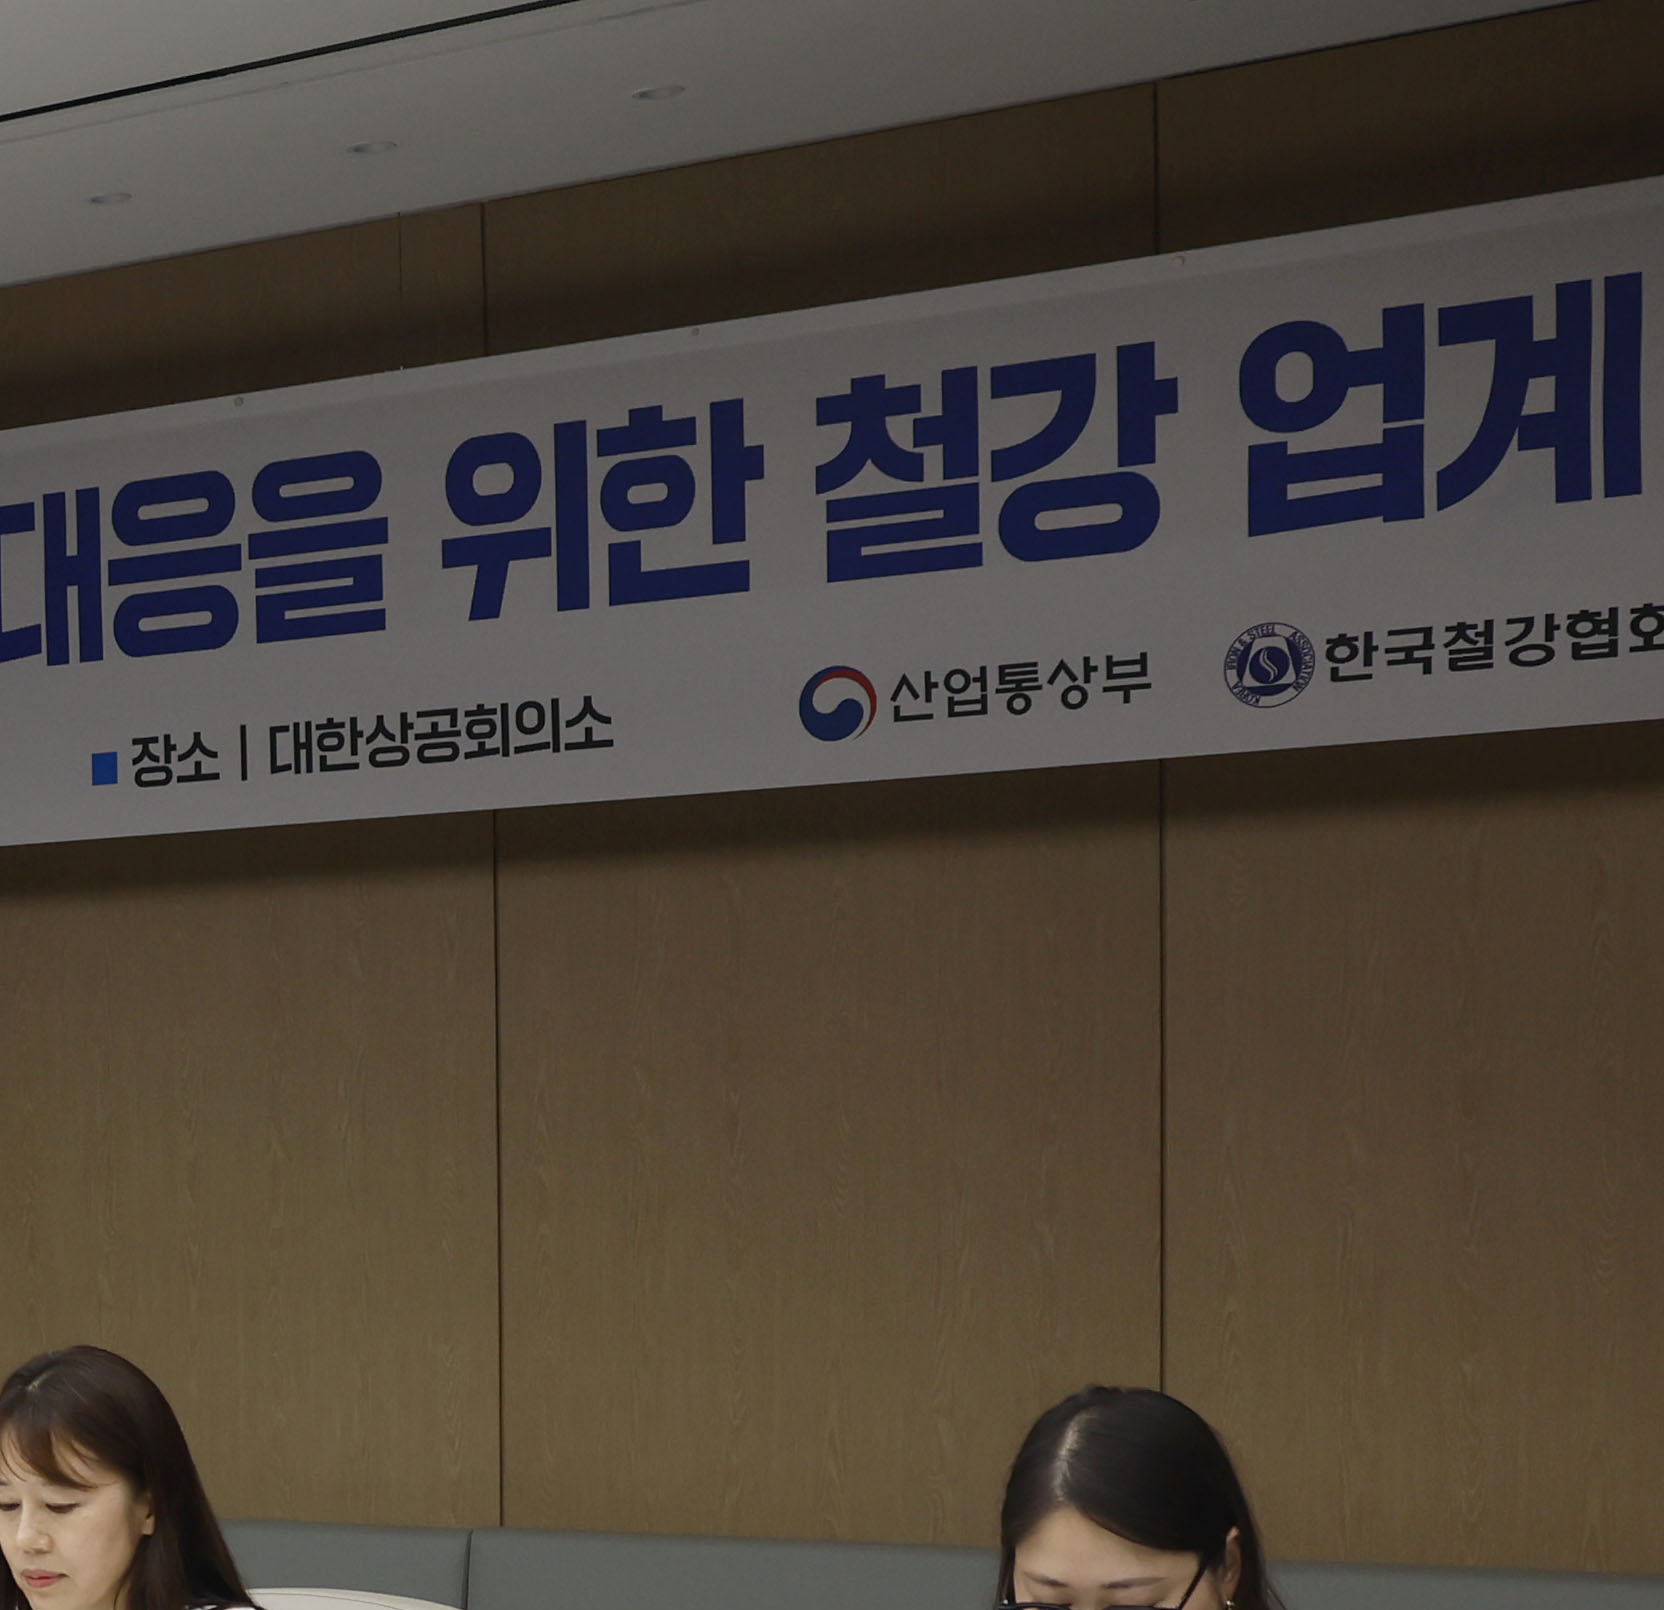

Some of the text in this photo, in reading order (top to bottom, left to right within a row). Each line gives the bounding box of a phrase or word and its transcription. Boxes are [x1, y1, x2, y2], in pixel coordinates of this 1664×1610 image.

[442, 398, 764, 621] 위한
[816, 341, 1178, 583] 철강
[1239, 272, 1642, 537] 업계
[891, 652, 1151, 722] 산업통상부
[132, 696, 613, 787] 장소 대한상공회의소
